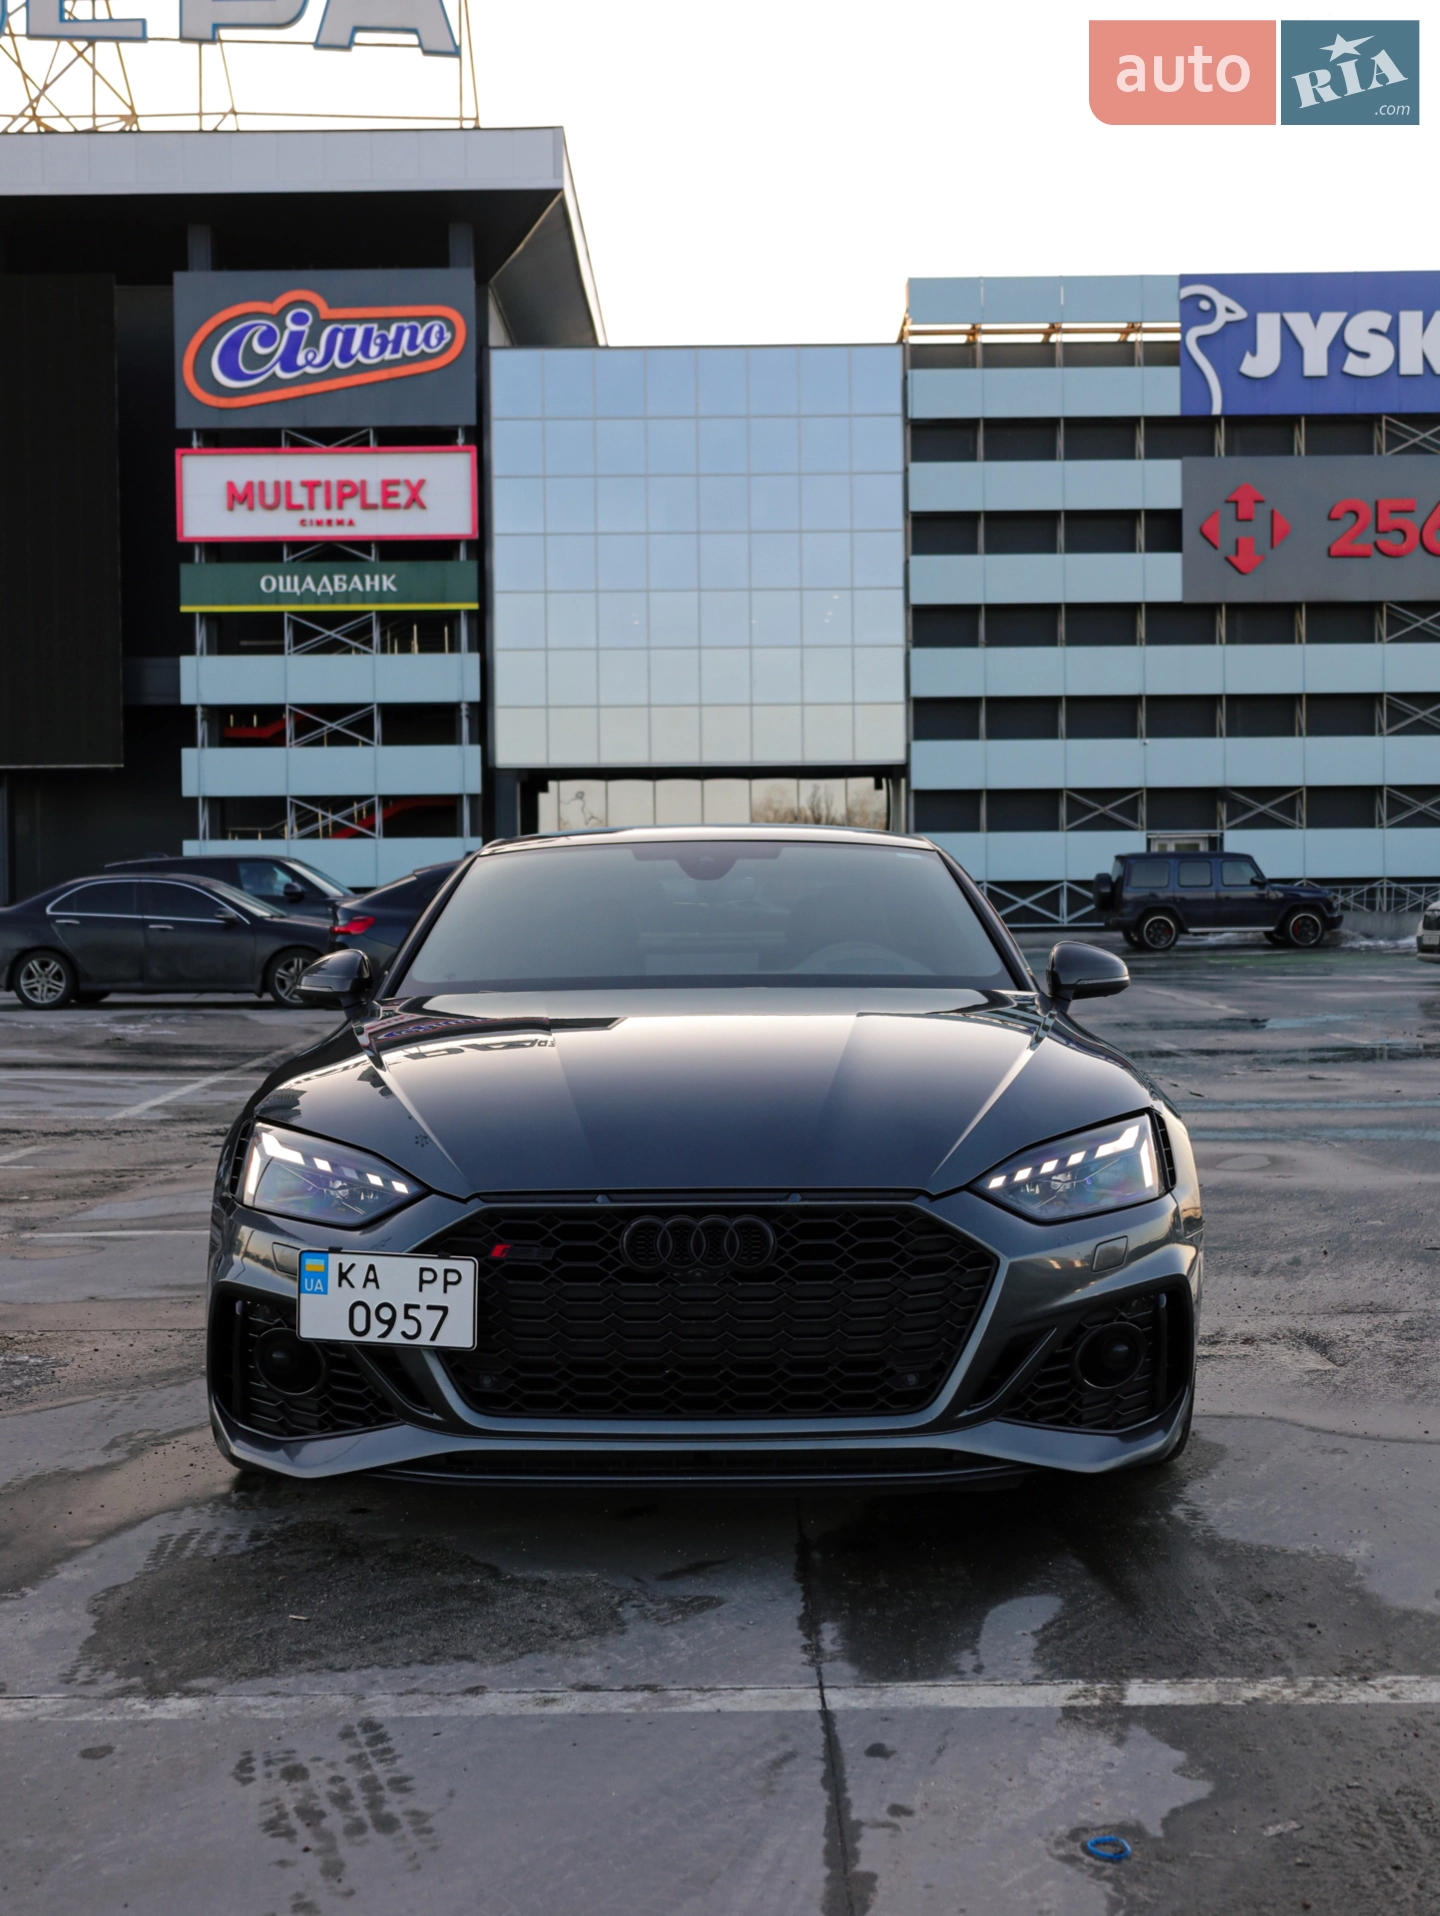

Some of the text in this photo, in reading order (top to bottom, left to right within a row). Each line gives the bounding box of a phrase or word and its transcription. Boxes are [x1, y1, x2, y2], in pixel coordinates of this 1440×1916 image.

[211, 308, 451, 388] Сільпо
[1238, 310, 1440, 378] JYSK
[225, 478, 427, 511] MULTIPLEX
[298, 517, 356, 527] CINEMA
[259, 574, 398, 596] ОЩАДБАНК
[304, 1277, 325, 1292] UA
[337, 1262, 463, 1294] KA PP
[347, 1299, 449, 1342] 0957
